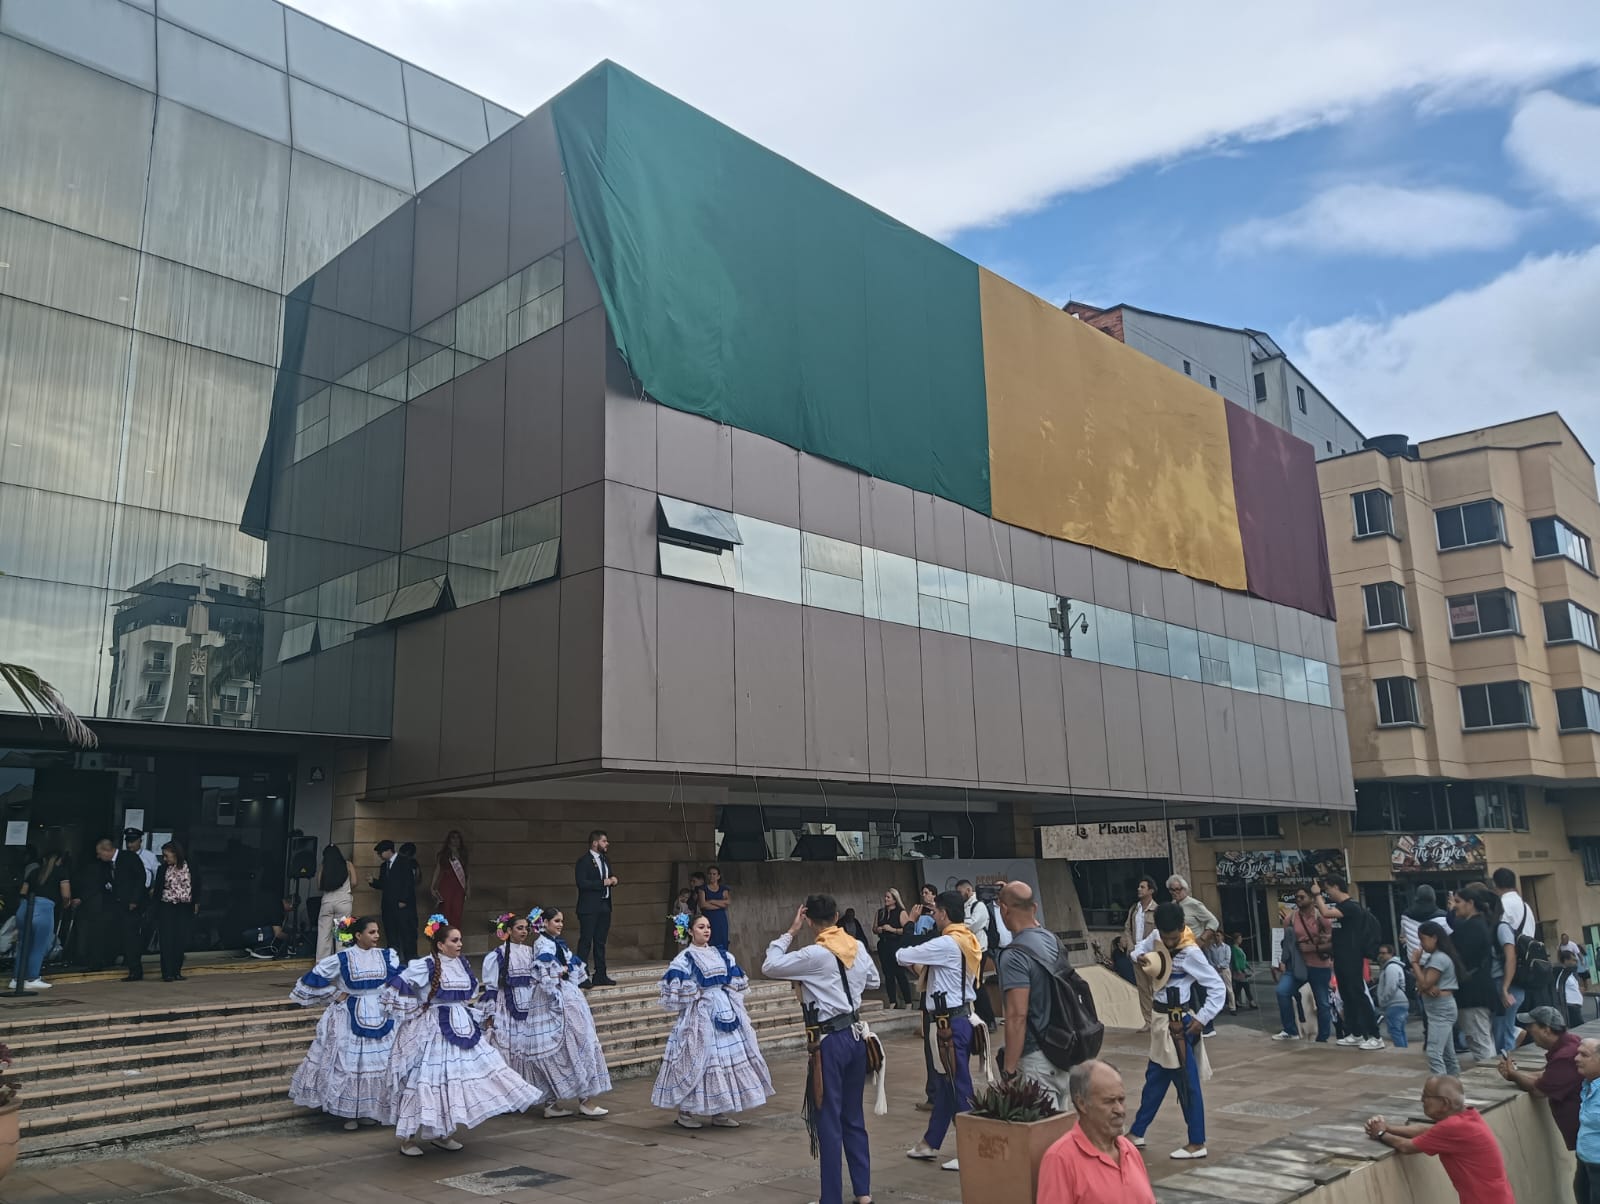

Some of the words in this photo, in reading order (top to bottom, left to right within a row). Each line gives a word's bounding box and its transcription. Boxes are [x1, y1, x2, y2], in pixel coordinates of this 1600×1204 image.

[1077, 823, 1088, 839] La
[1098, 821, 1147, 835] Plazuela
[1410, 846, 1429, 863] The
[1431, 845, 1466, 864] Dukes
[1218, 861, 1236, 876] The
